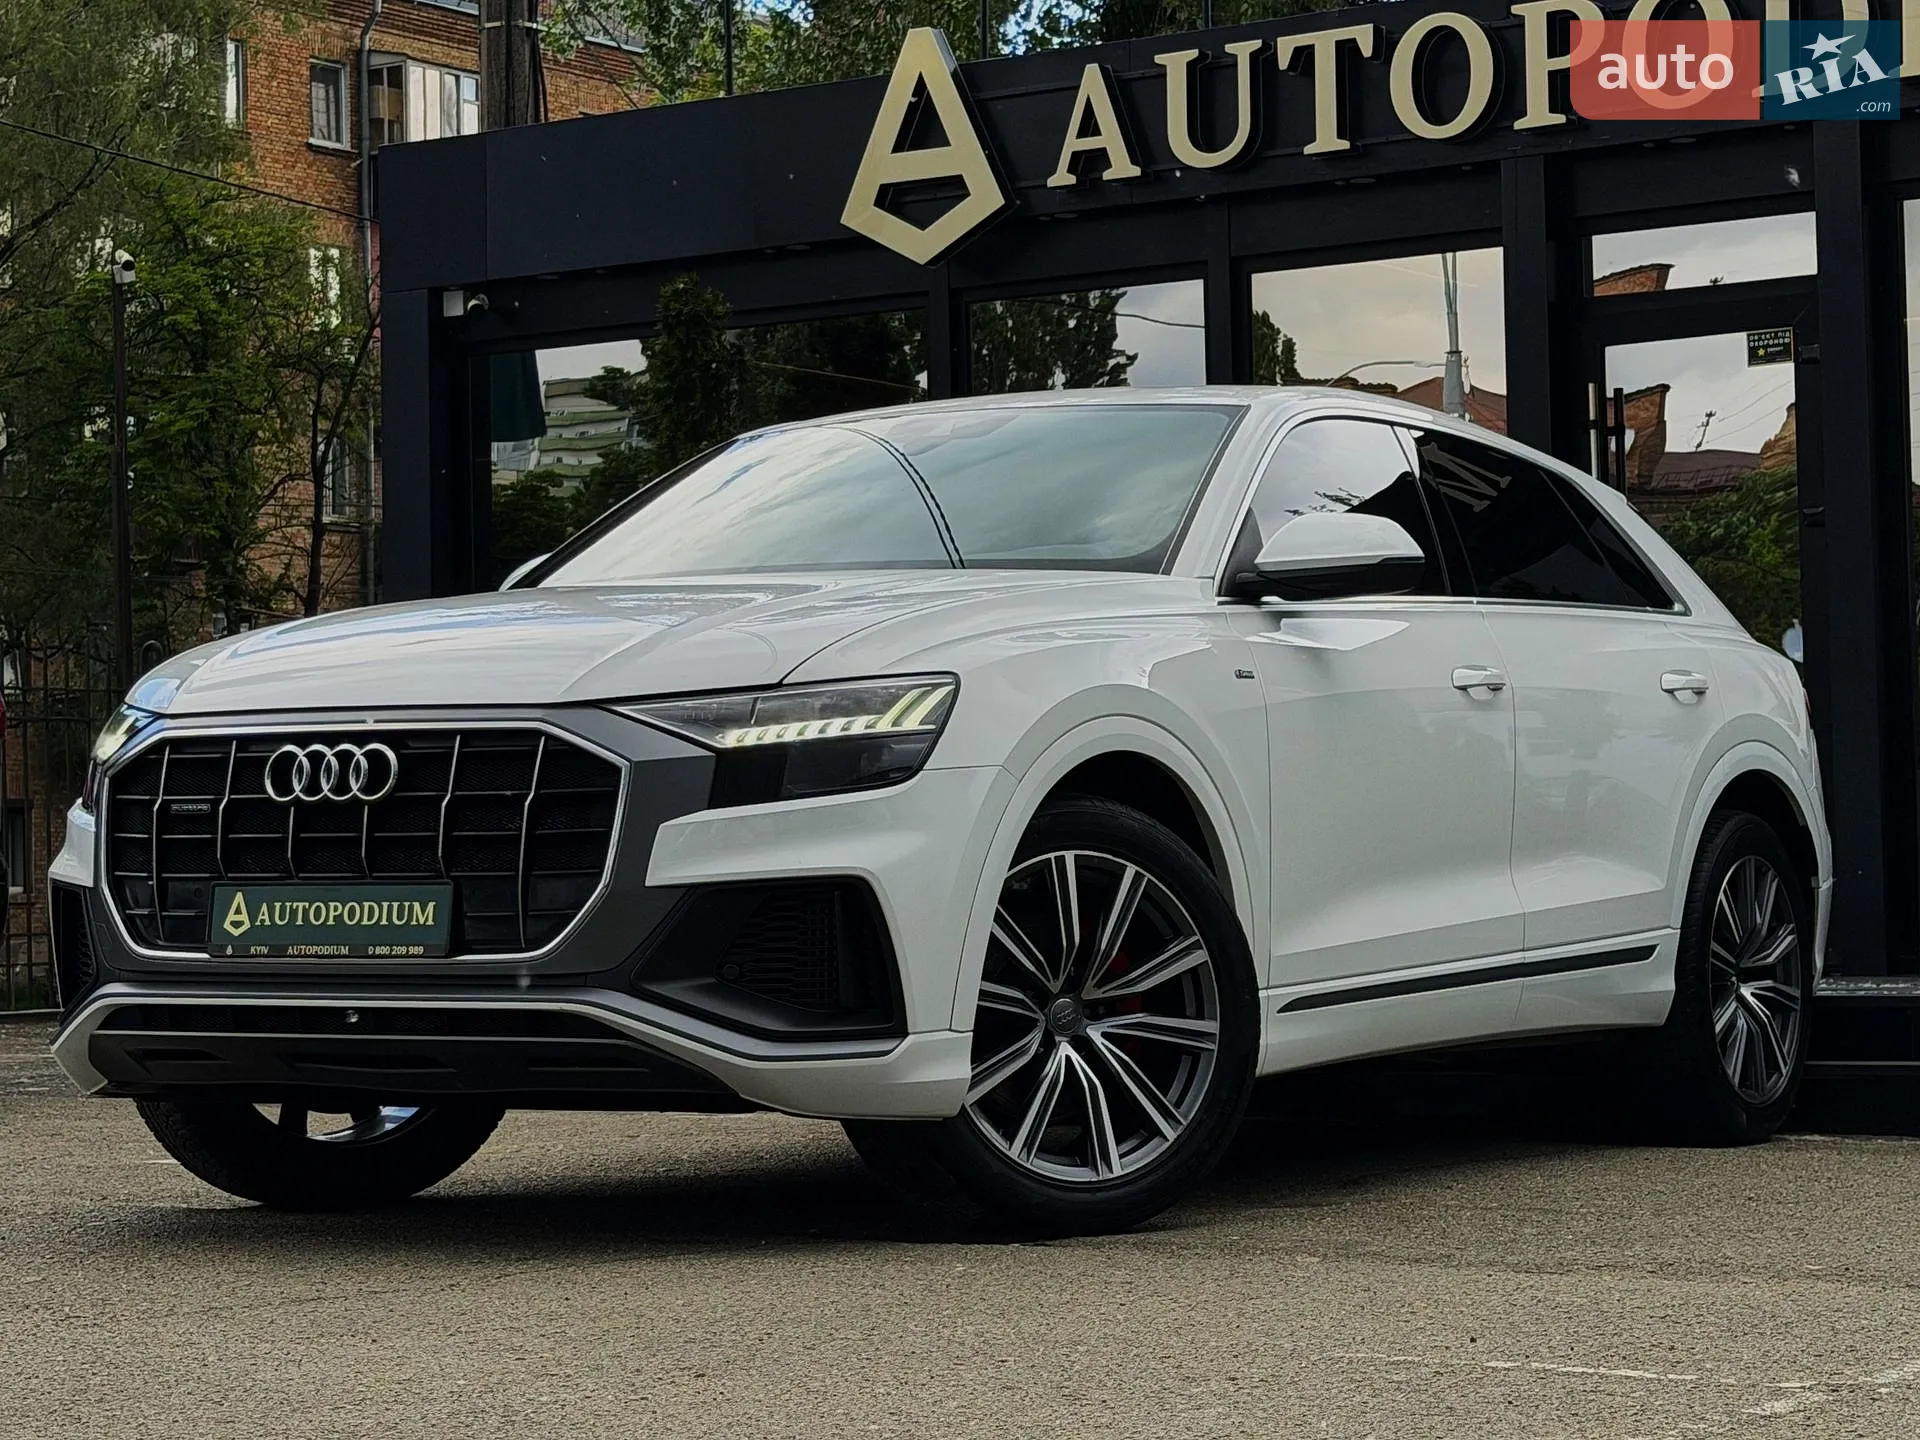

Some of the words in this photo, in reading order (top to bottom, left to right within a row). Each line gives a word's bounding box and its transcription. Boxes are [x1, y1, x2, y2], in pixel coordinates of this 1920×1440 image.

[255, 901, 436, 926] AUTOPODIUM
[250, 945, 269, 955] KYIV
[287, 945, 349, 955] AUTOPODIUM
